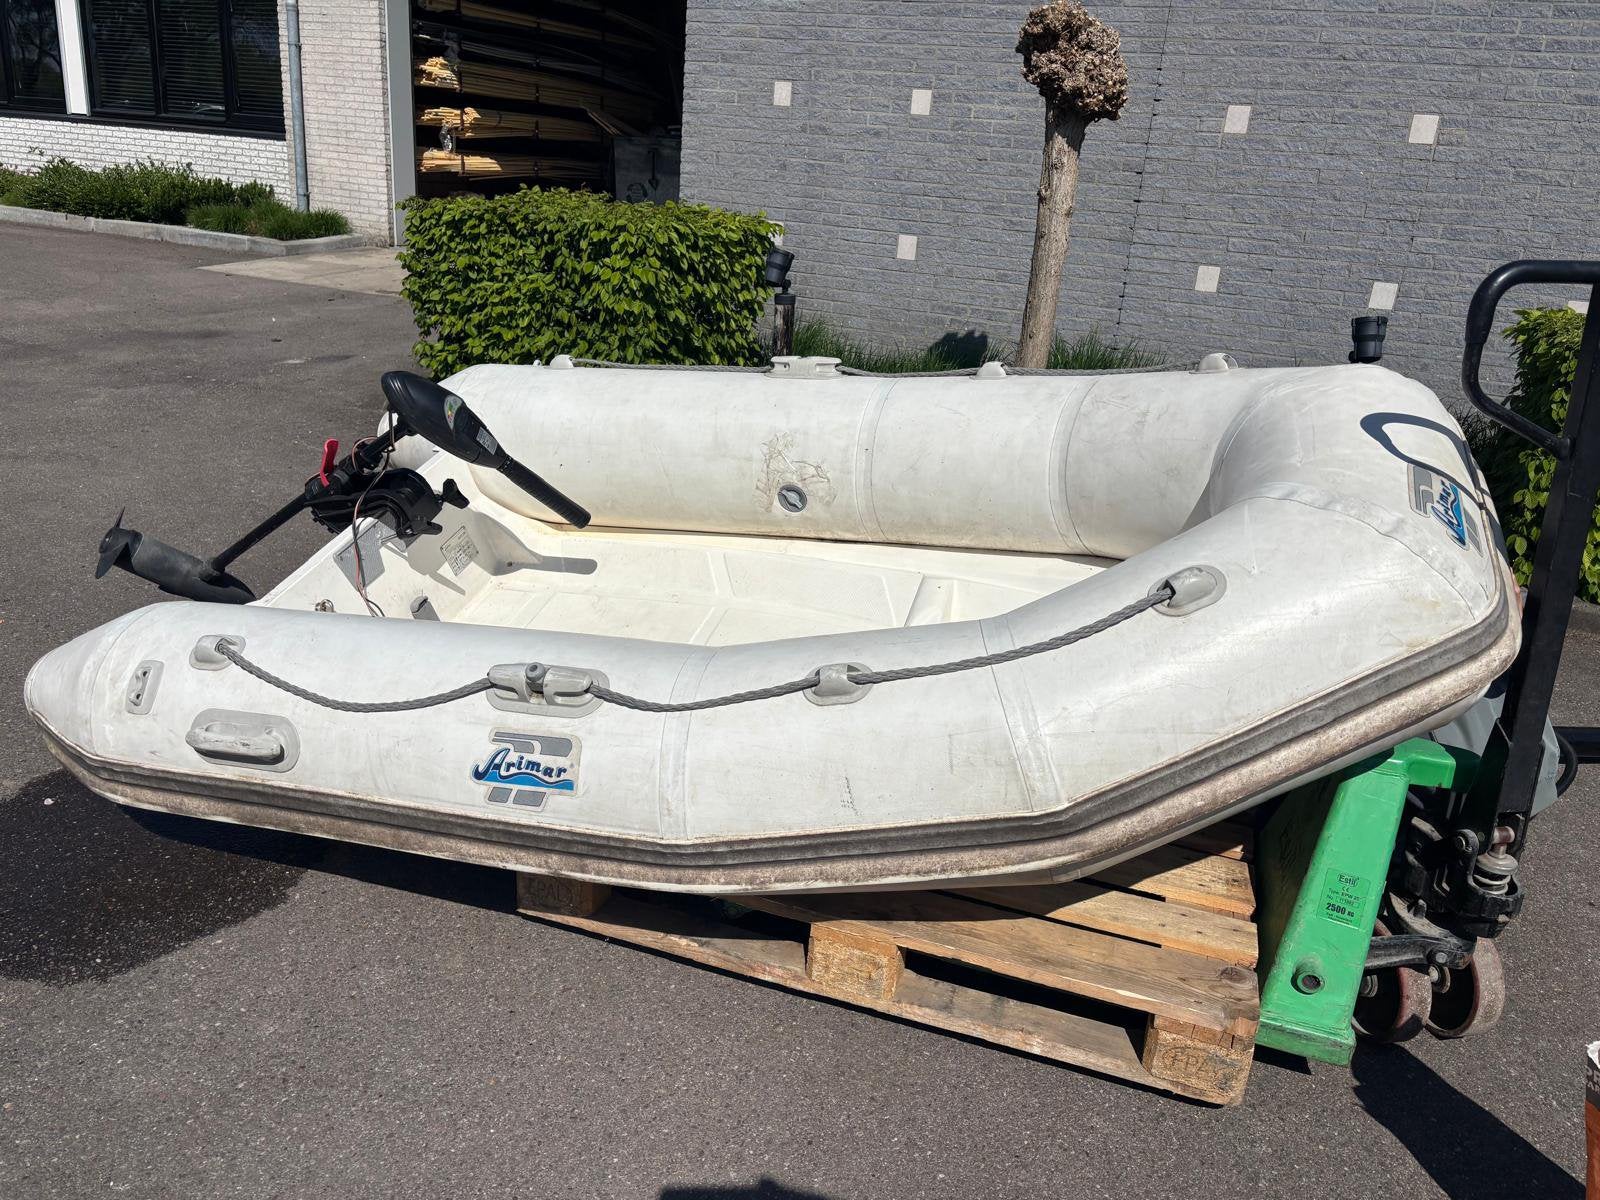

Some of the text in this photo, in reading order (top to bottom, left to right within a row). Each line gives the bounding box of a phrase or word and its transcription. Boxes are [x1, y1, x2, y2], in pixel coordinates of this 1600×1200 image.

[1431, 479, 1466, 546] Arimar
[473, 747, 569, 781] Arimar
[1326, 902, 1347, 915] 2500
